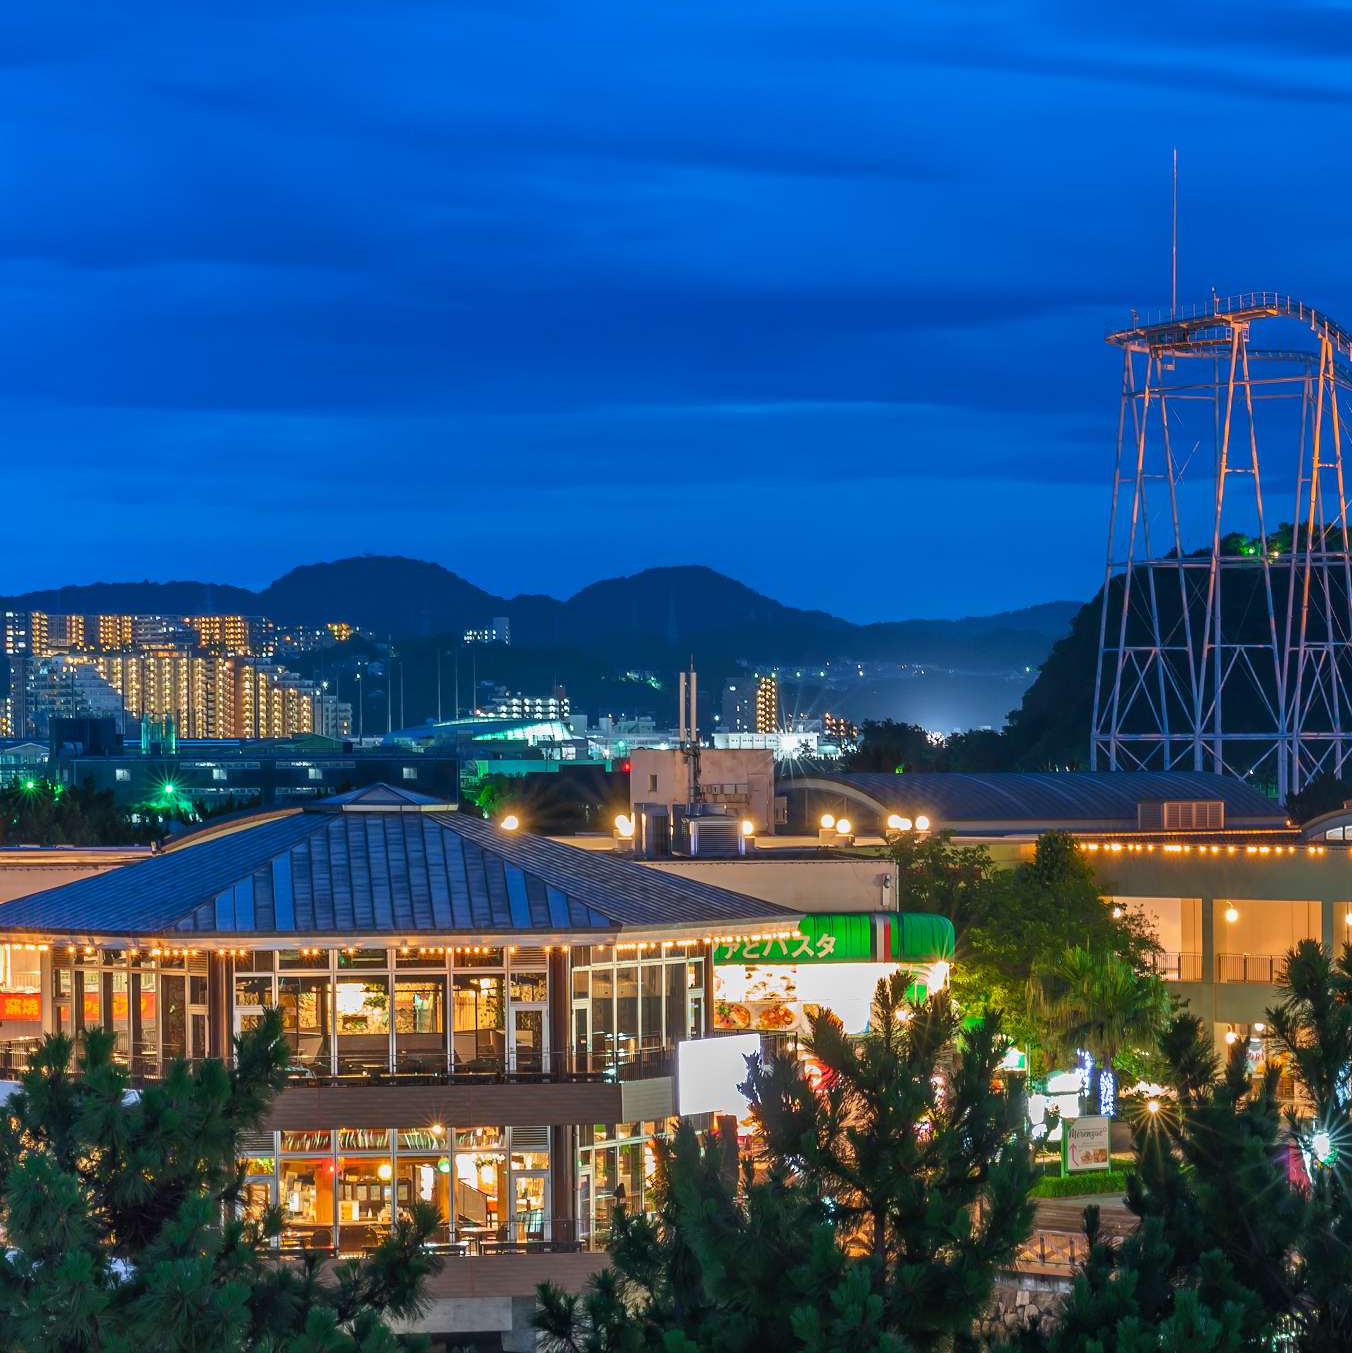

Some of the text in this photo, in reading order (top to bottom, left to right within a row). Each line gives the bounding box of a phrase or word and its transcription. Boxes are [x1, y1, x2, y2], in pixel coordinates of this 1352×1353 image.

[713, 933, 836, 959] ァとパスタ
